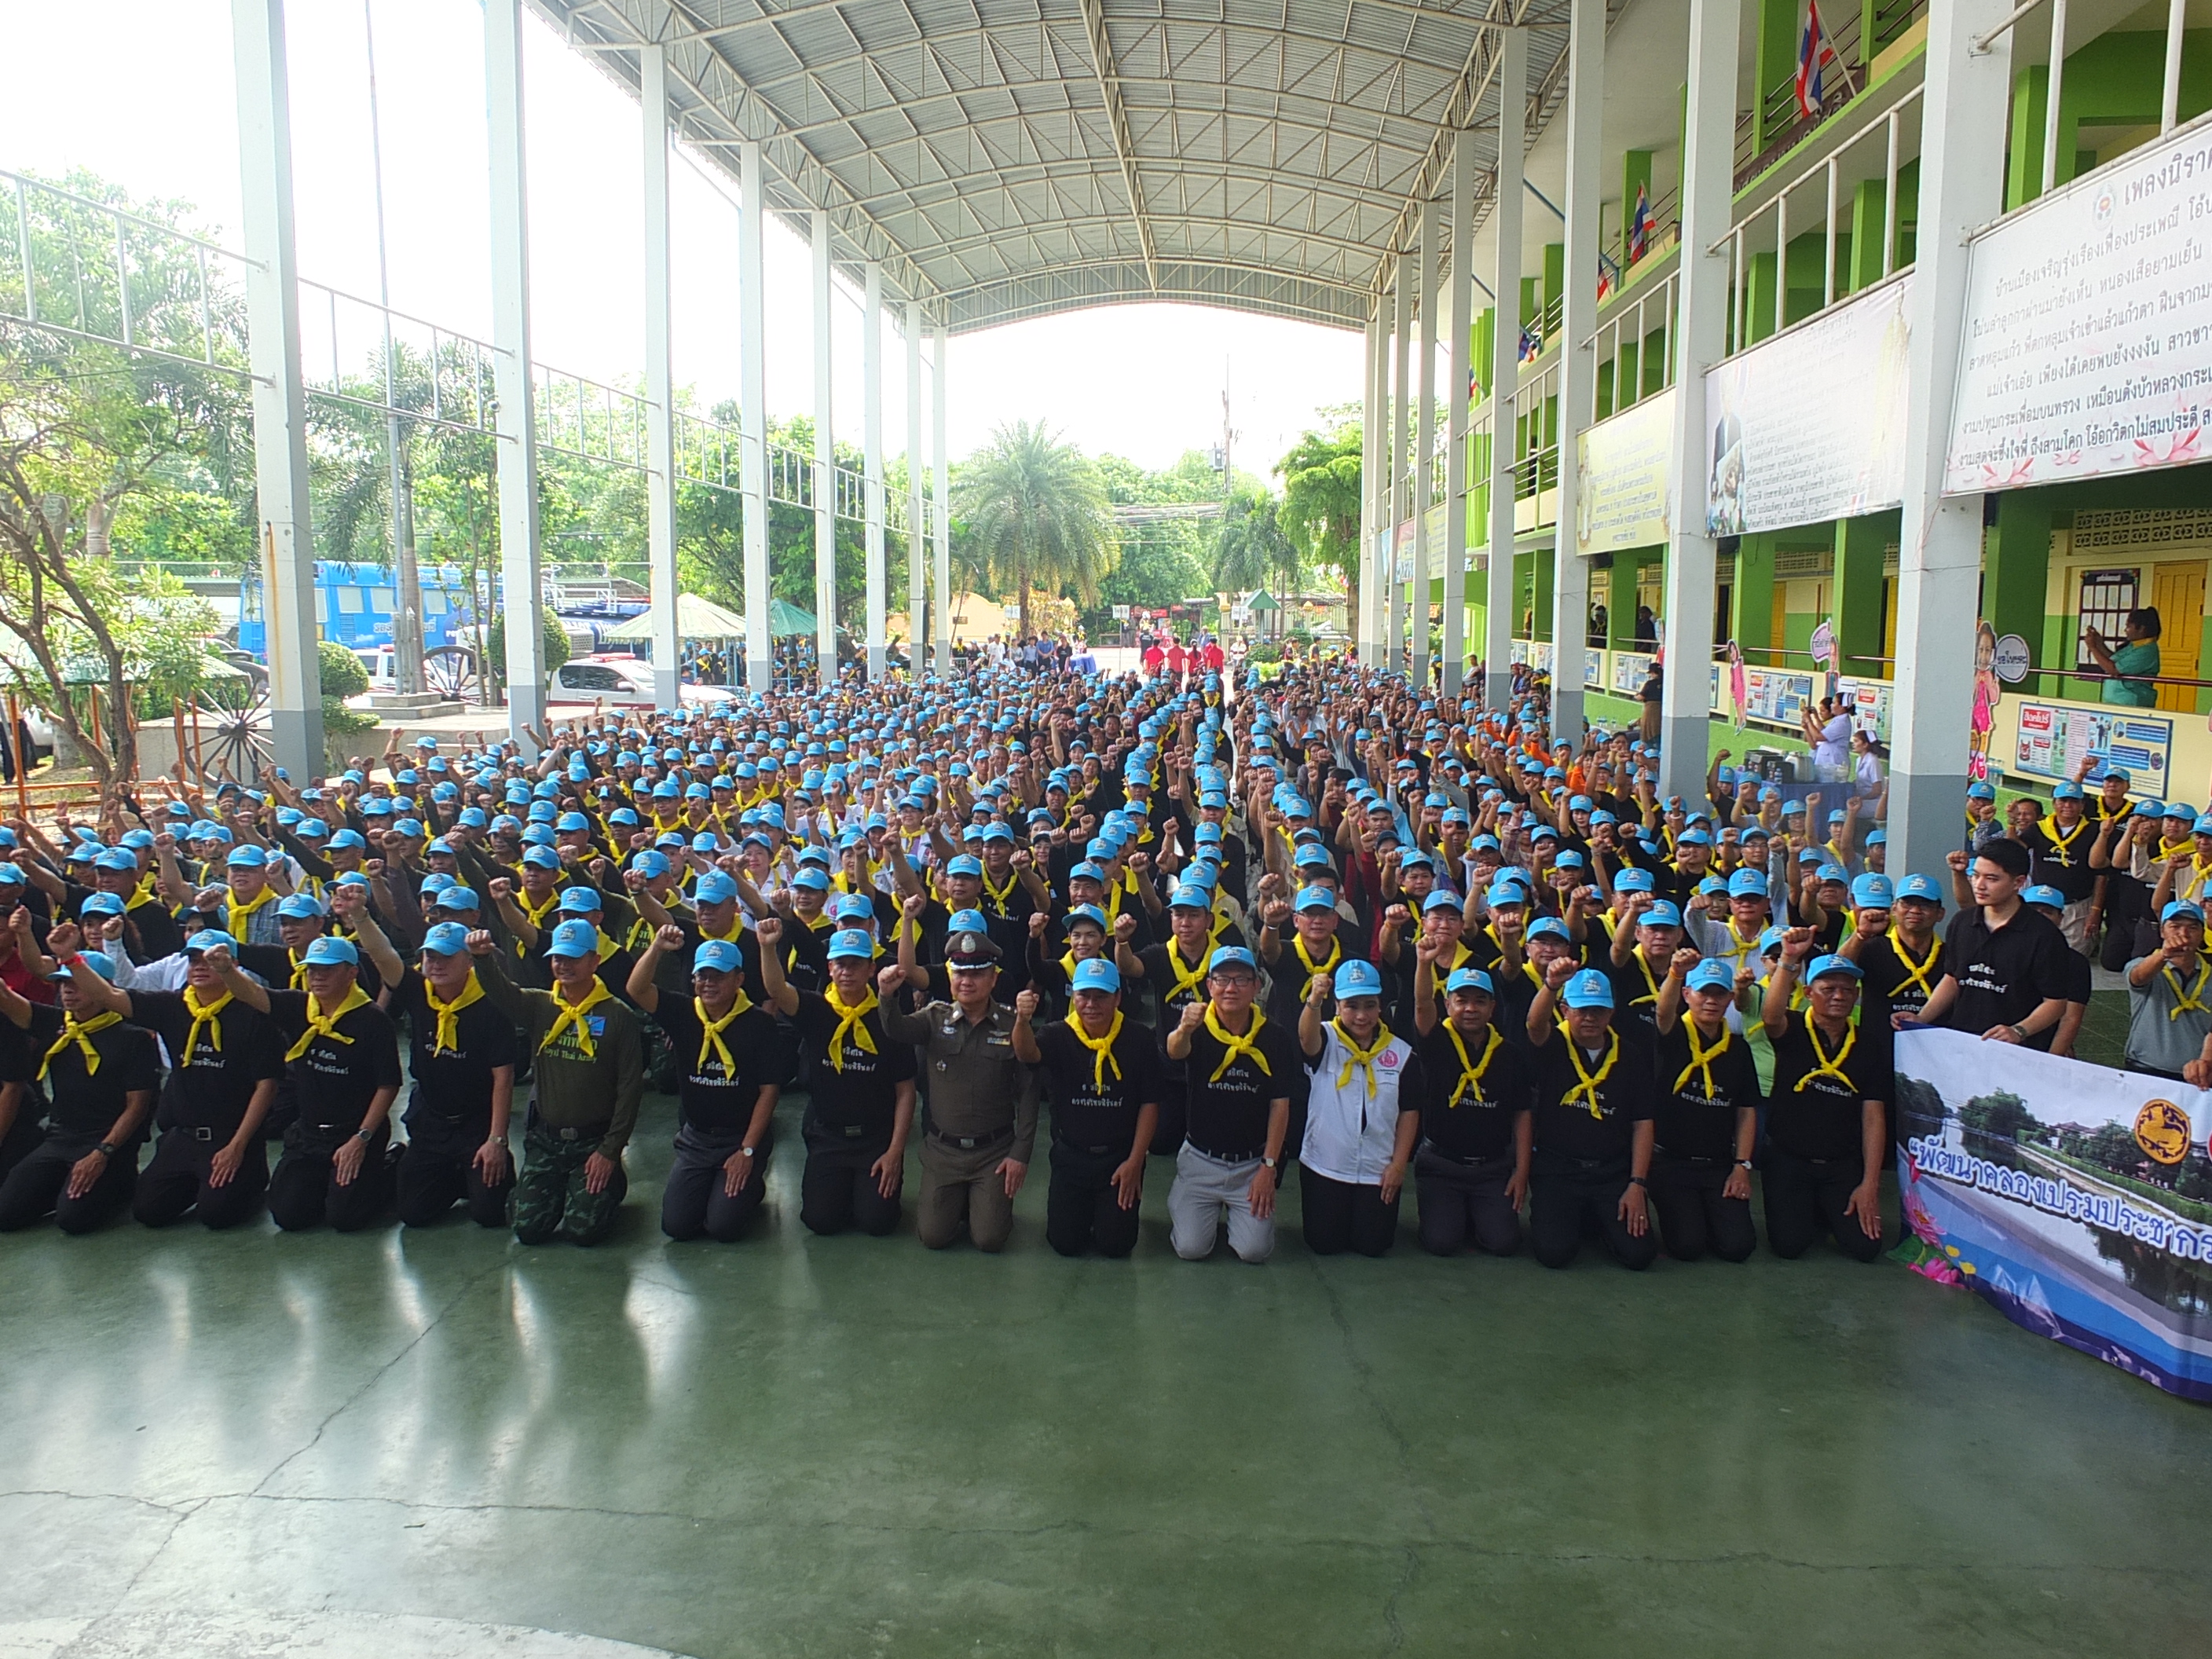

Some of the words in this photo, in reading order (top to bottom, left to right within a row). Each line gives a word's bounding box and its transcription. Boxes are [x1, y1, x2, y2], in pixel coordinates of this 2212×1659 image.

[2100, 236, 2203, 294] หนองเสือยามเย็น
[2031, 428, 2083, 456] ถึงสามโคก
